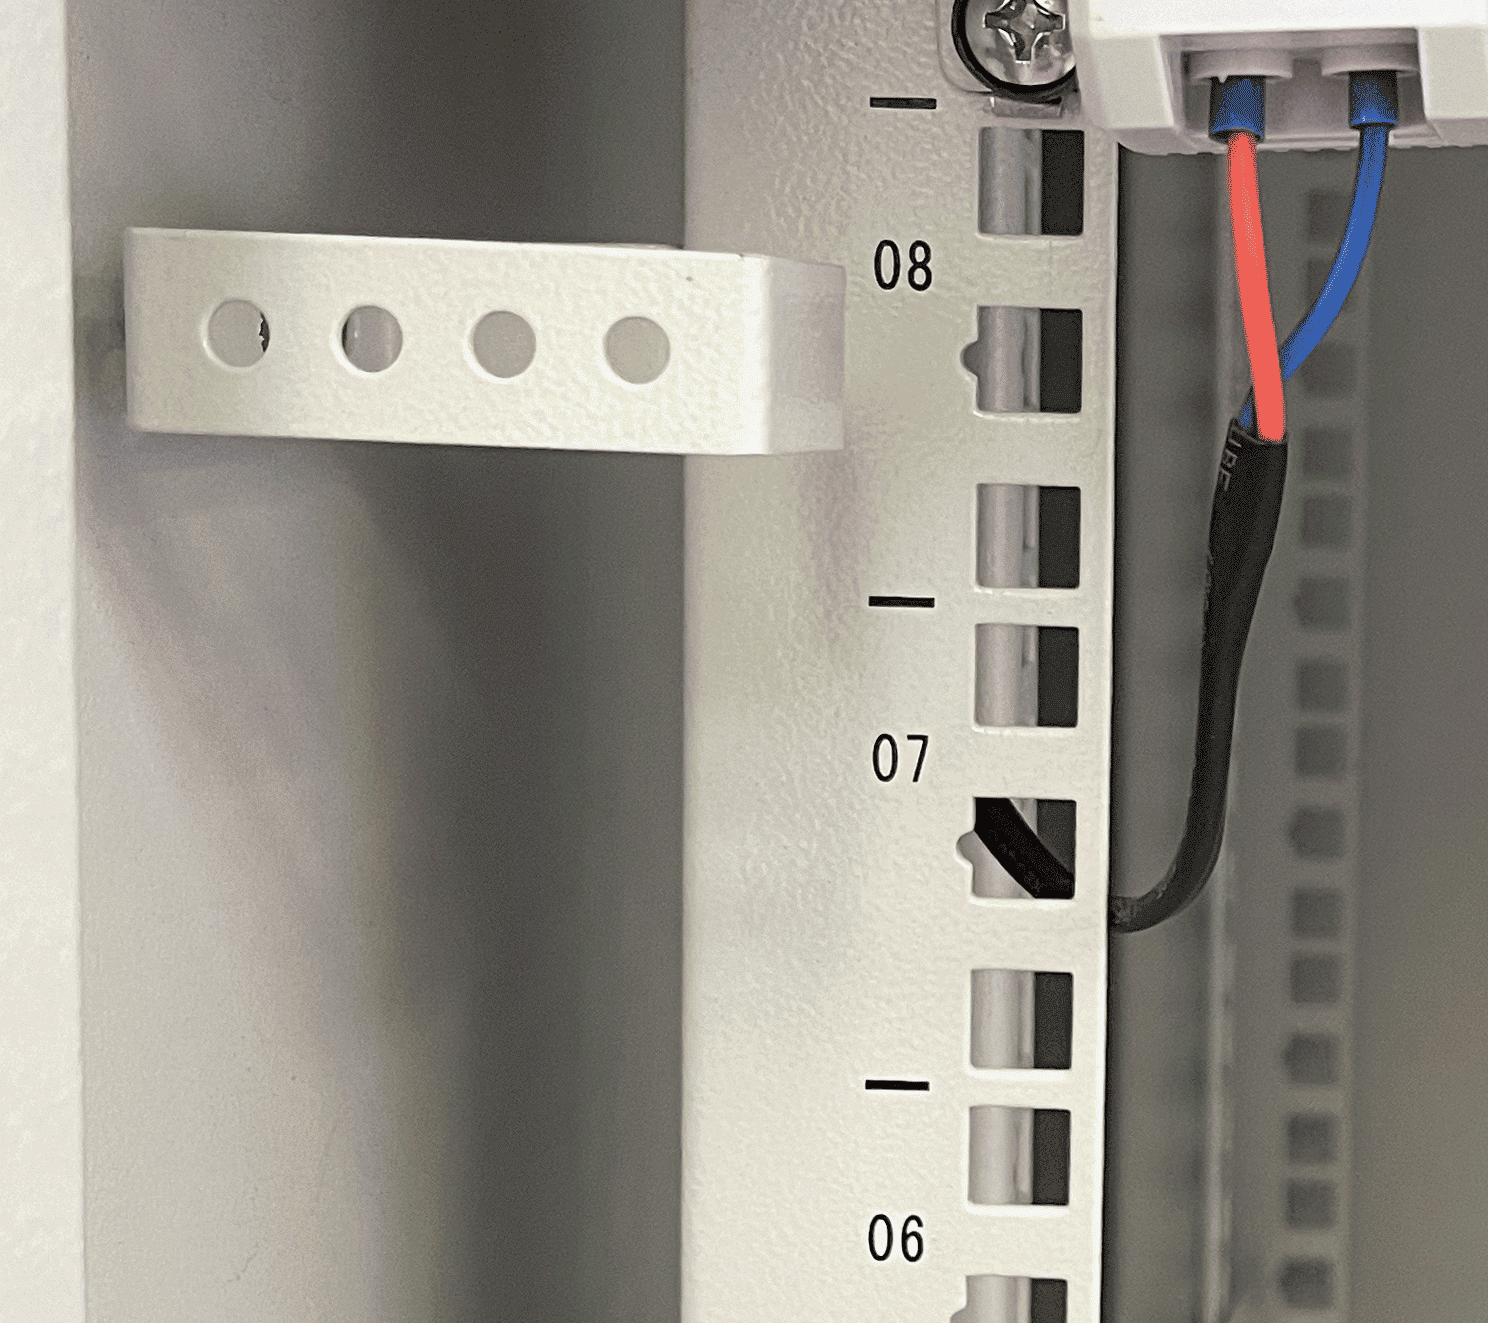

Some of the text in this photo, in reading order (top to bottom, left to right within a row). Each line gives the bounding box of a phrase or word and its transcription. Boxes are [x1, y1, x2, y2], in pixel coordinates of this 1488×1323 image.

[873, 239, 933, 292] 08
[872, 732, 929, 783] 07
[867, 1213, 924, 1263] 06
